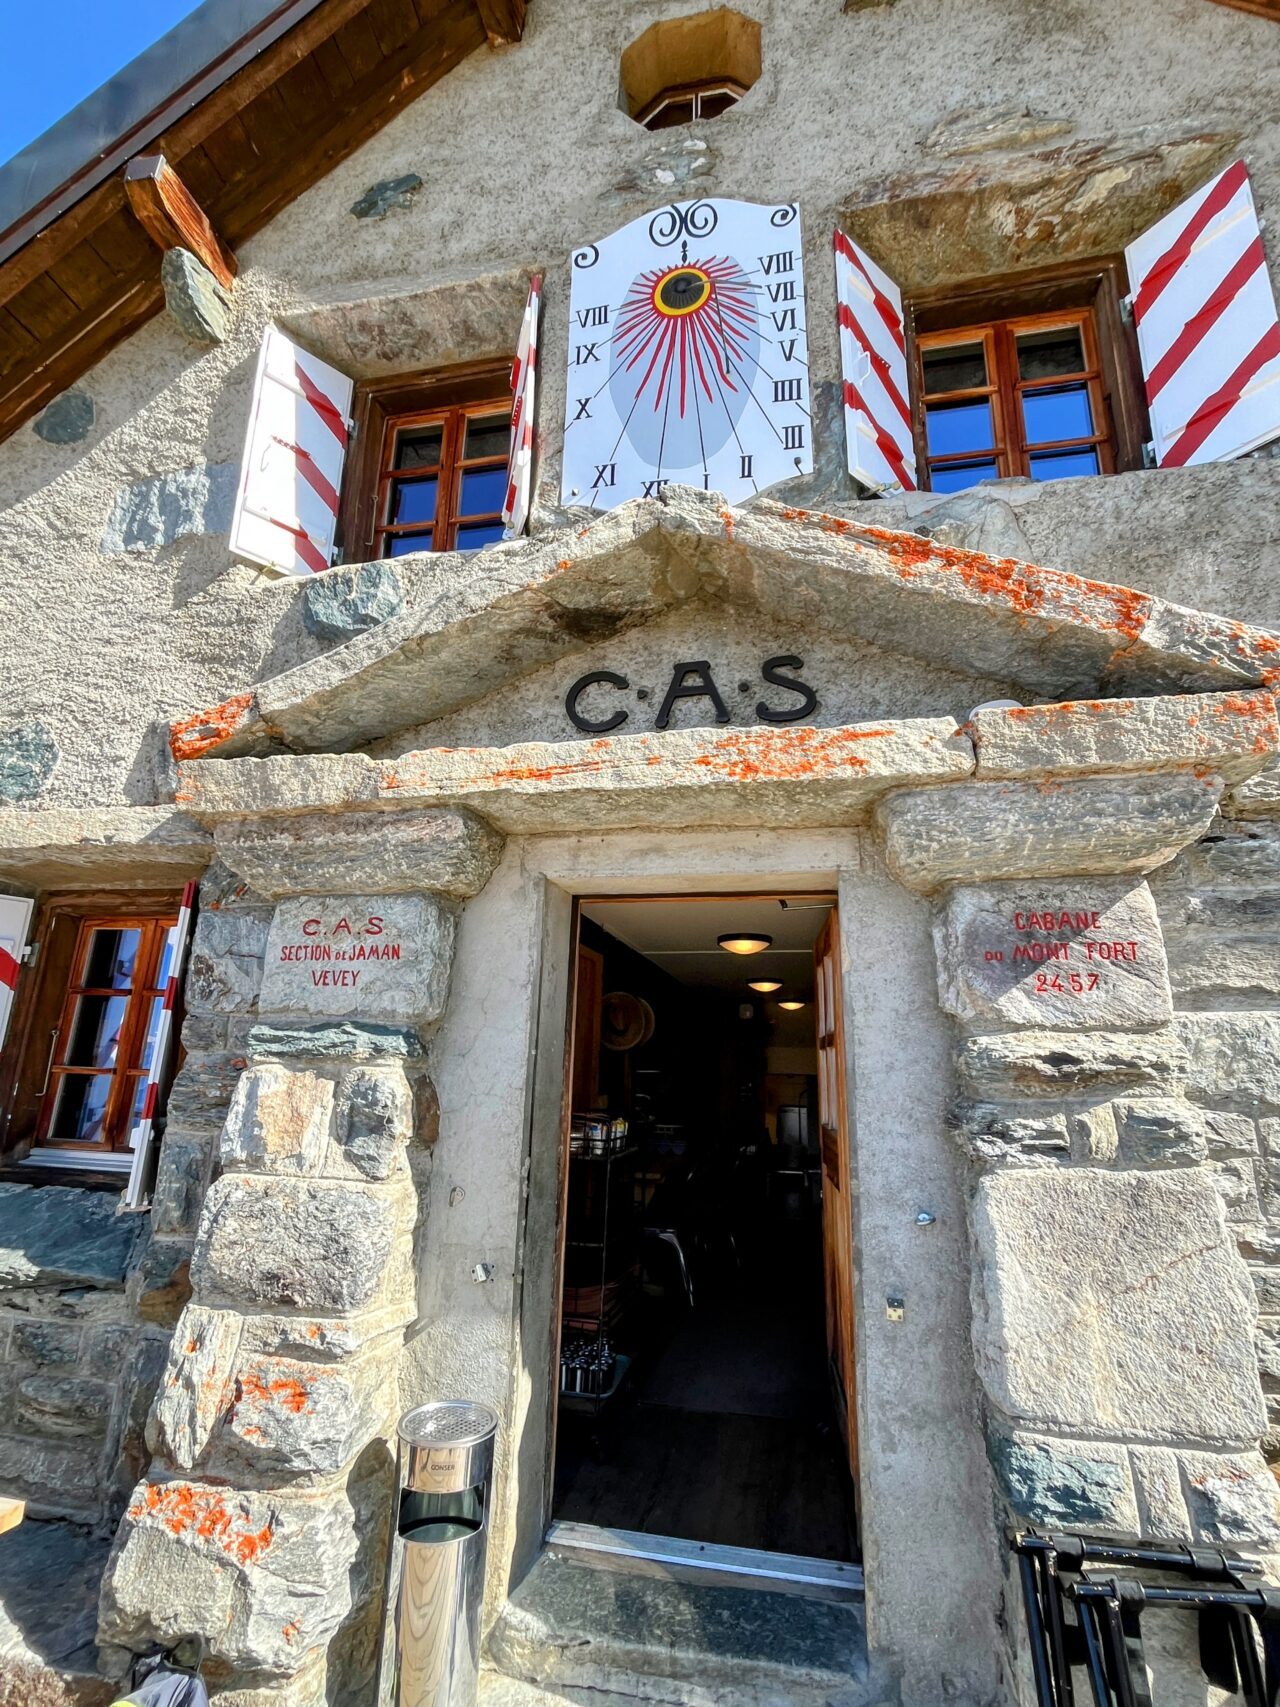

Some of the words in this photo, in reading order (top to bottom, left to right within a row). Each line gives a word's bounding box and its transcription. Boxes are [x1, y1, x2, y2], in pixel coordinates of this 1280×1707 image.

[757, 251, 793, 275] VIII
[765, 281, 797, 302] VII
[576, 305, 610, 328] VIII
[771, 308, 797, 332] VI
[575, 343, 600, 365] IX
[778, 339, 798, 362] V
[772, 378, 803, 402] IIII
[573, 397, 593, 420] X
[782, 425, 805, 450] III
[590, 463, 618, 489] XI
[740, 455, 754, 479] II
[640, 479, 670, 498] XI
[1014, 911, 1102, 931] CABANE
[280, 945, 331, 961] SECTION
[335, 950, 346, 960] DE
[350, 944, 401, 961] JAMAN
[984, 950, 1003, 962] DU
[1012, 941, 1070, 962] MONT
[1084, 941, 1139, 961] FORT
[311, 970, 361, 986] VEVEY
[1035, 973, 1101, 993] 2457
